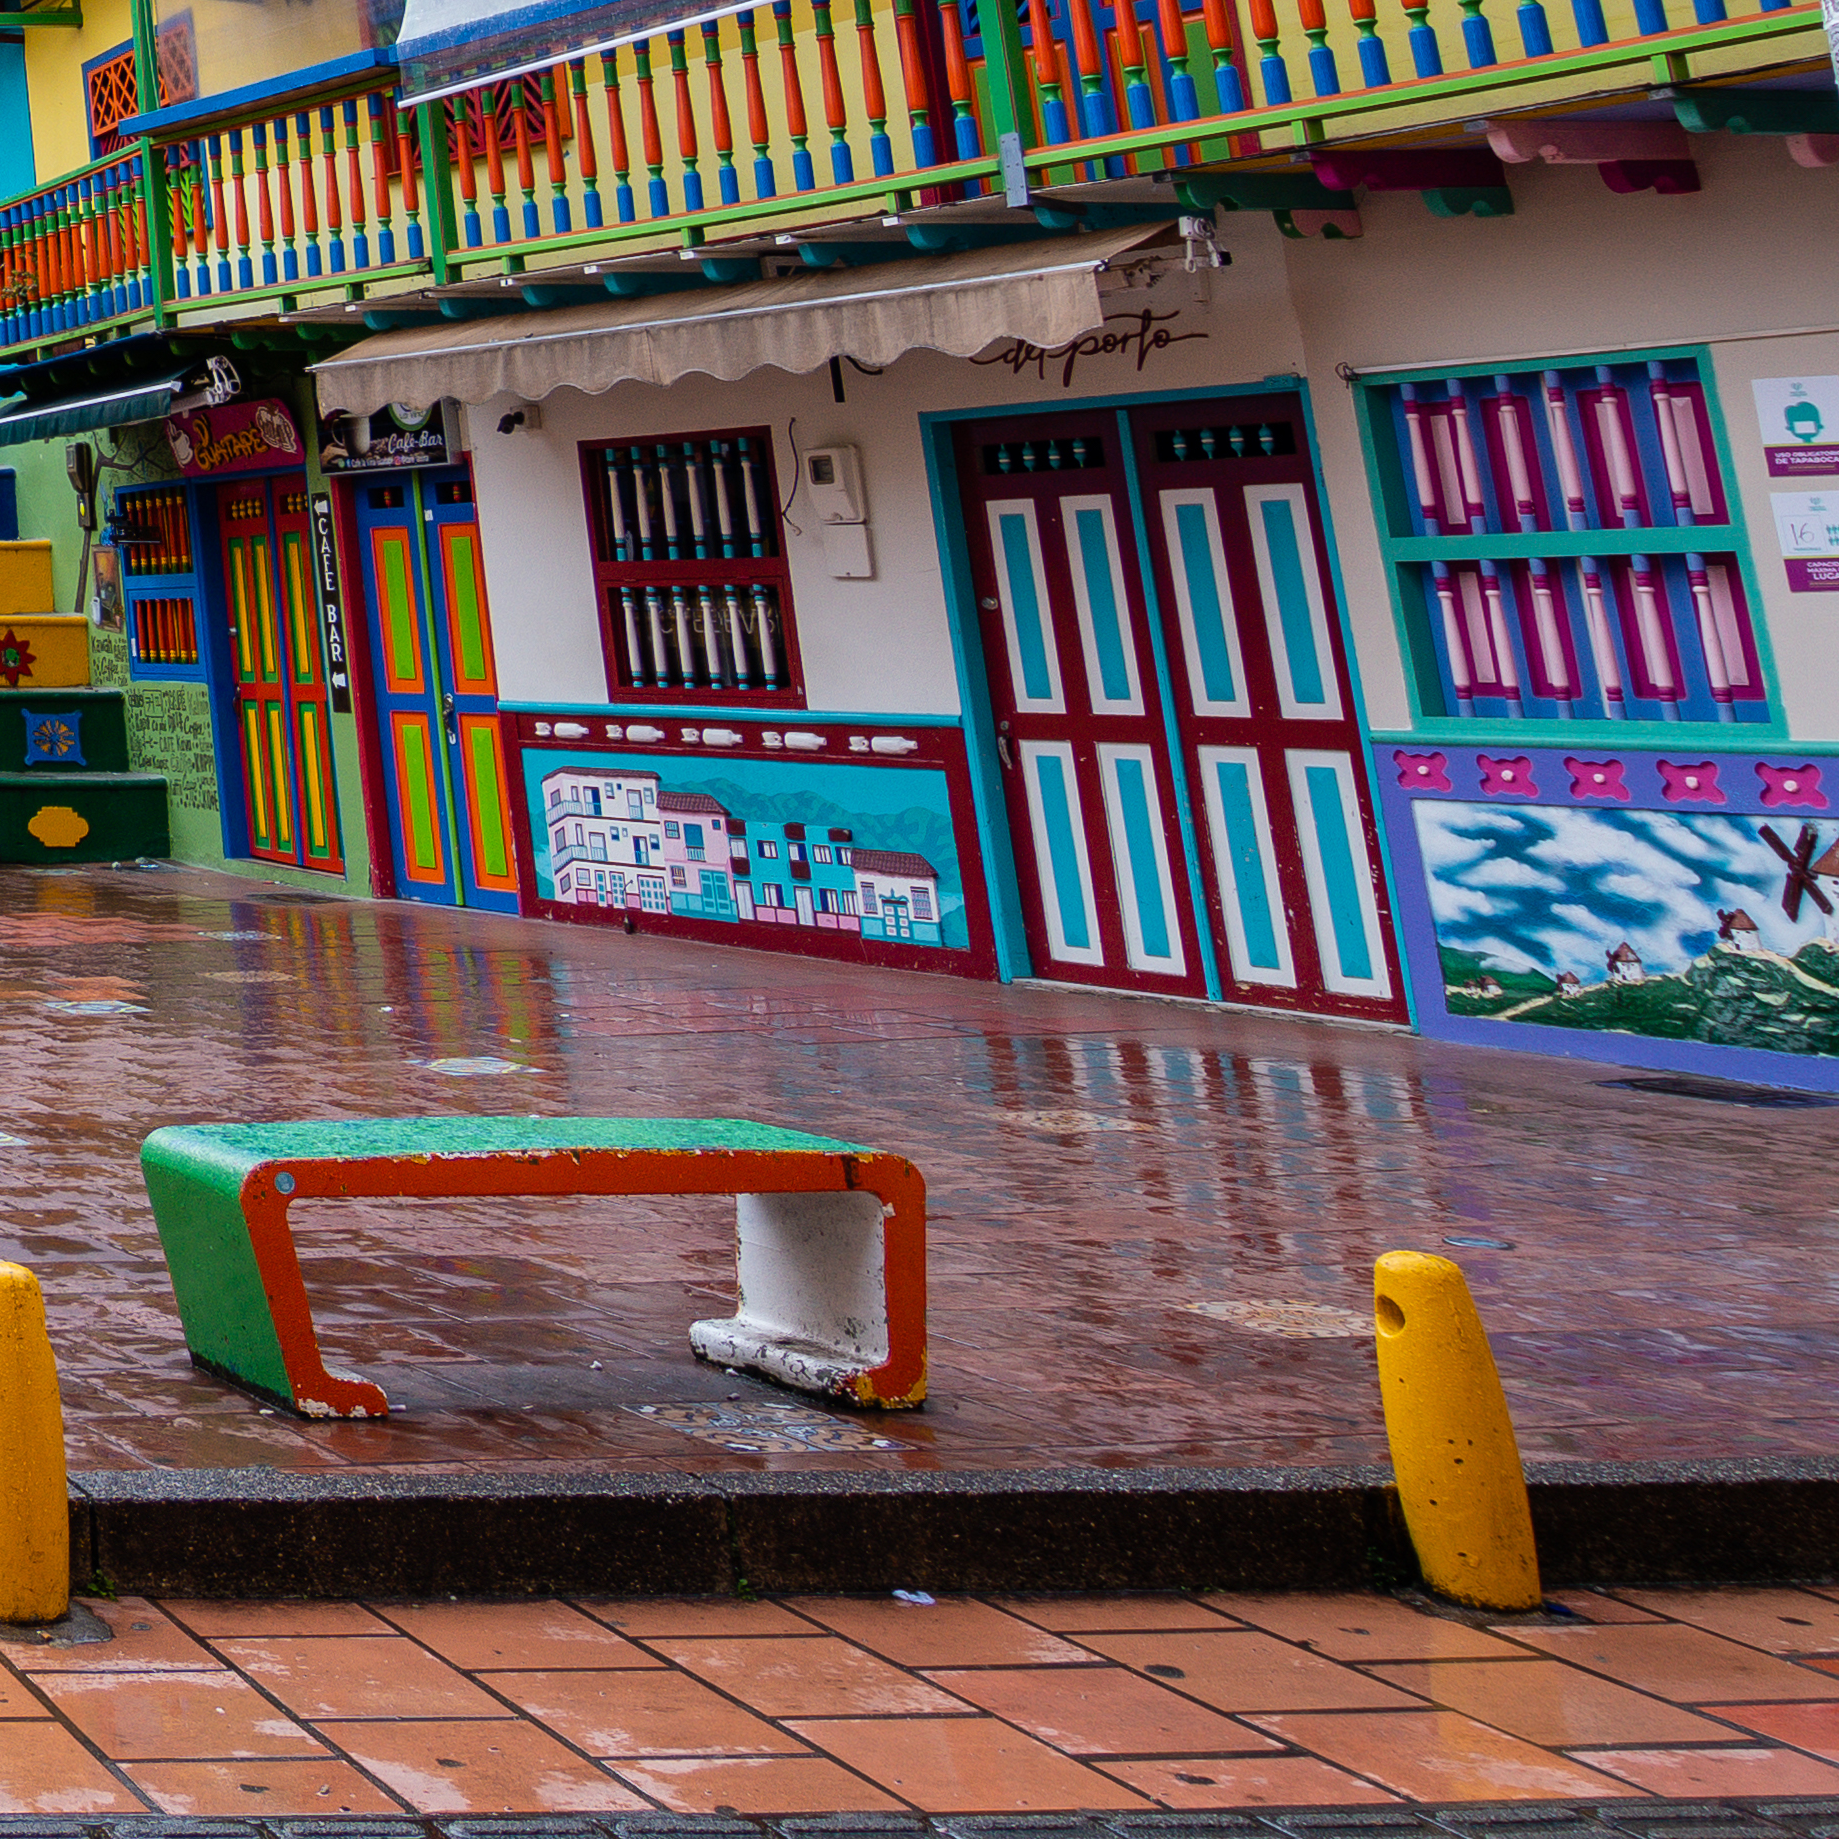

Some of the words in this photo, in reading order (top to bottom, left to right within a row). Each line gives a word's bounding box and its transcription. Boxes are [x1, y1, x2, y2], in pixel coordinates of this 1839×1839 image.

[1048, 309, 1209, 388] porto
[1790, 522, 1815, 546] 16
[326, 604, 343, 662] BAR
